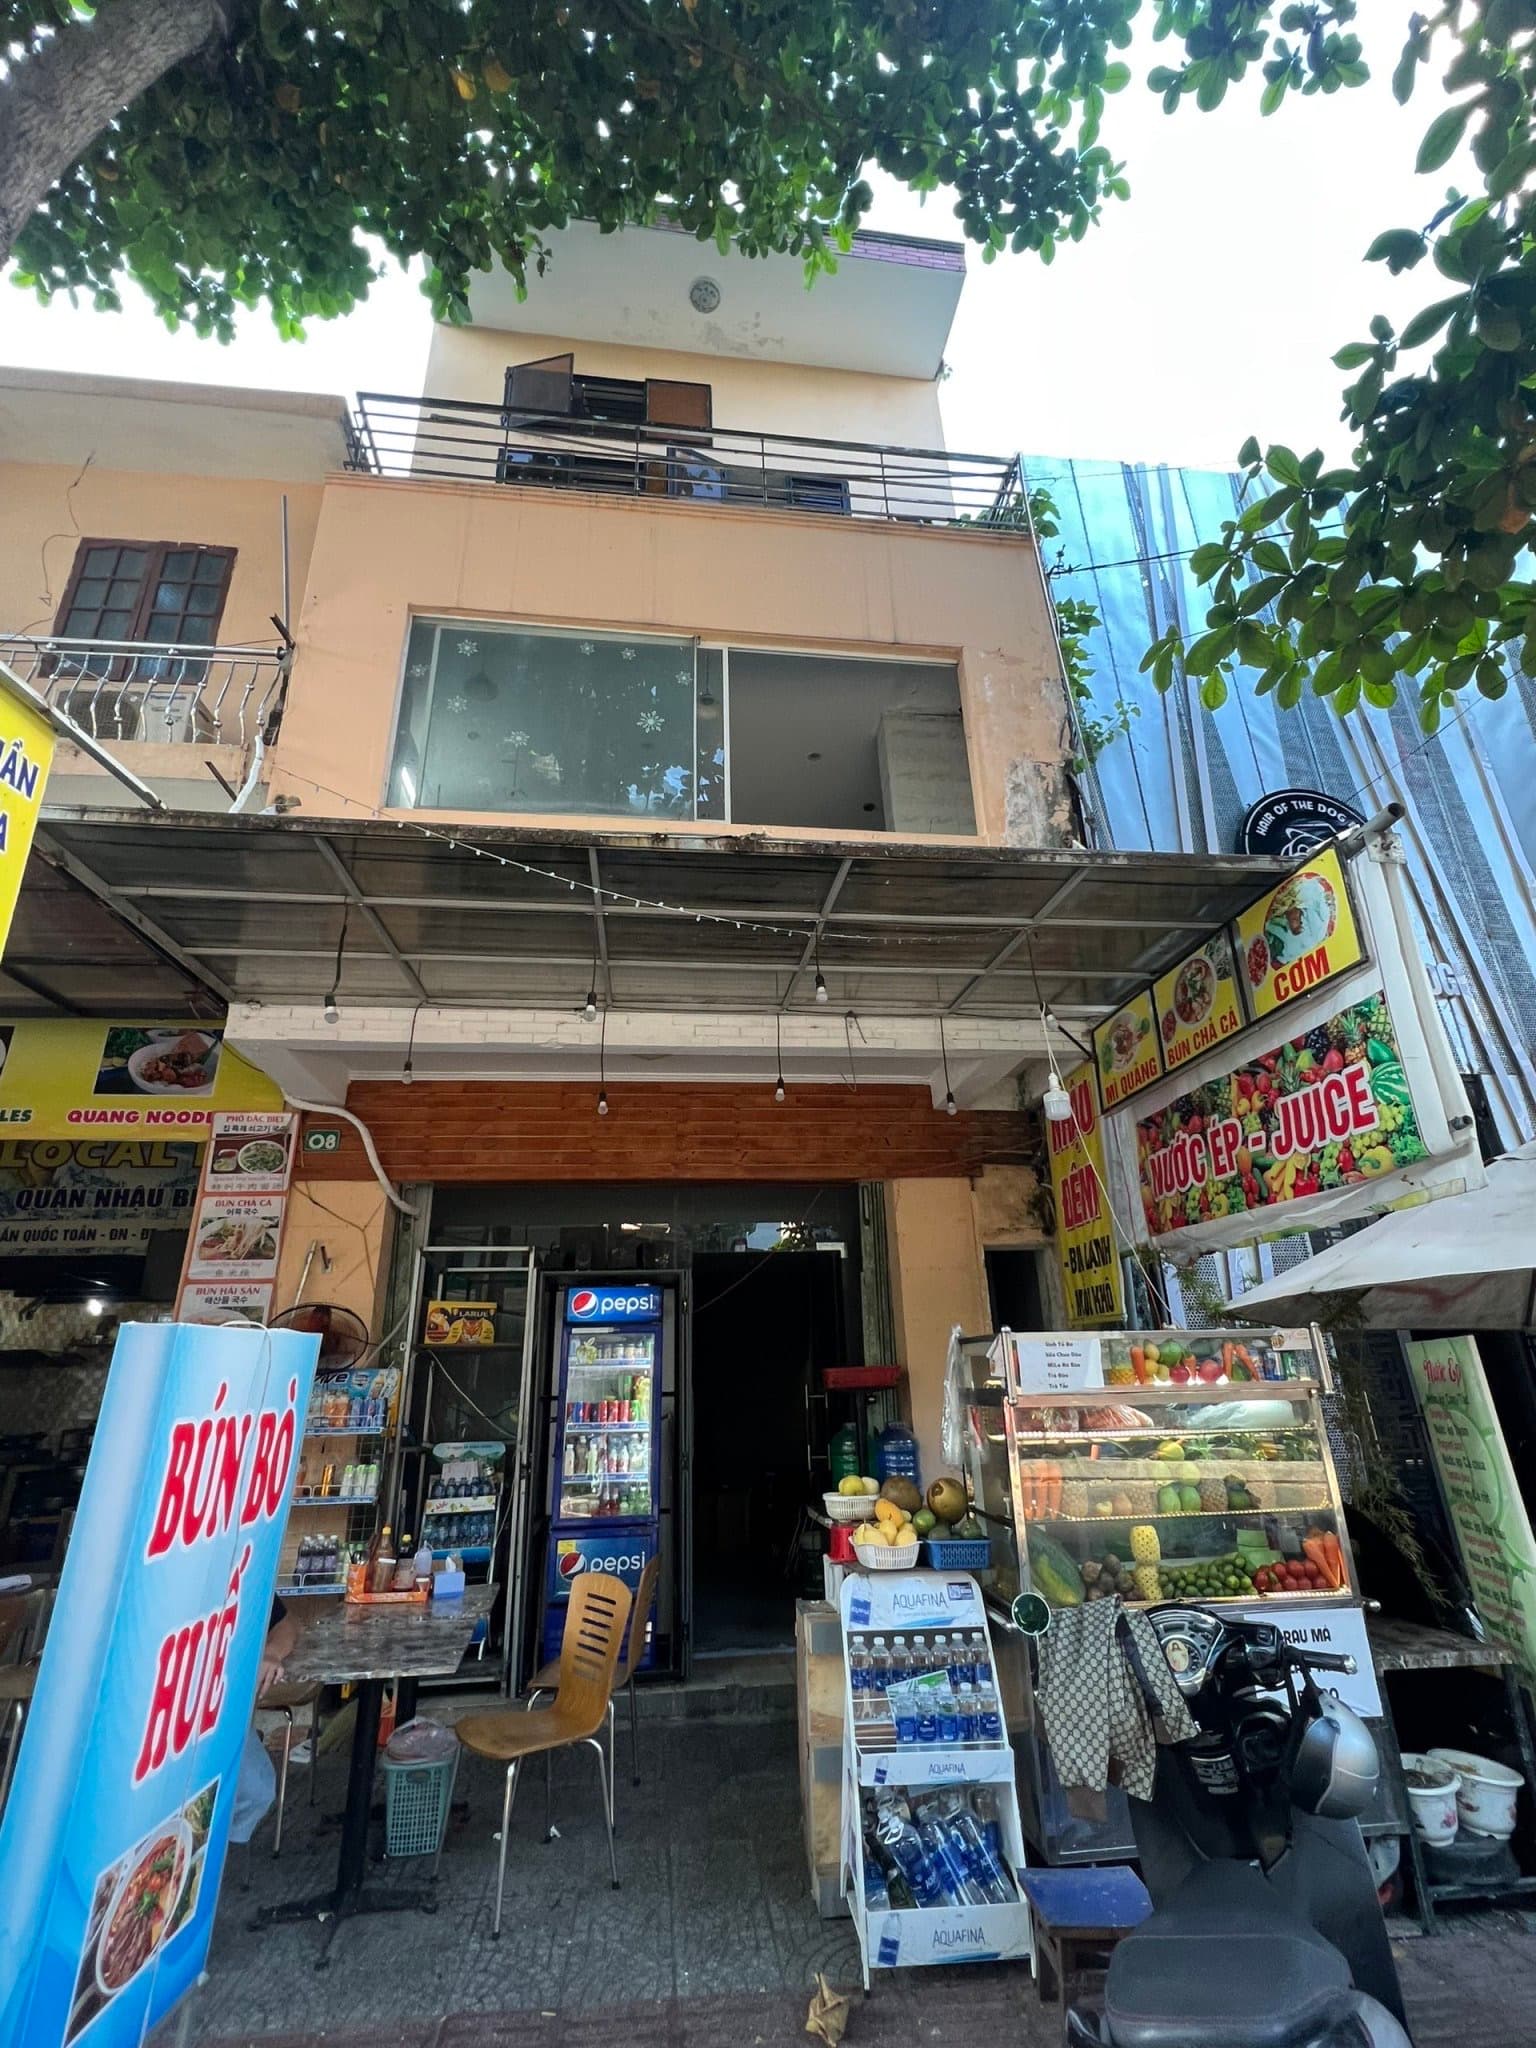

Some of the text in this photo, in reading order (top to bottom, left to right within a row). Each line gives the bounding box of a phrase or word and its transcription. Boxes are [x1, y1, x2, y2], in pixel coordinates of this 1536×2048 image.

[1255, 800, 1347, 836] HAIR OF THE DOG
[1273, 945, 1331, 1002] CƠM
[67, 1110, 140, 1124] QUANG
[1208, 1117, 1240, 1178] ÉP
[1275, 1065, 1377, 1156] JUICE
[308, 1134, 336, 1149] 08
[0, 1141, 178, 1169] LOCAL
[600, 1293, 655, 1316] pepsi
[147, 1381, 252, 1558] BÚN
[590, 1550, 646, 1576] pepsi
[892, 1591, 949, 1611] AQUAFINA
[134, 1544, 252, 1783] HUẾ
[928, 1762, 966, 1776] AQUAFINA
[932, 1926, 986, 1949] AQUAFINA
